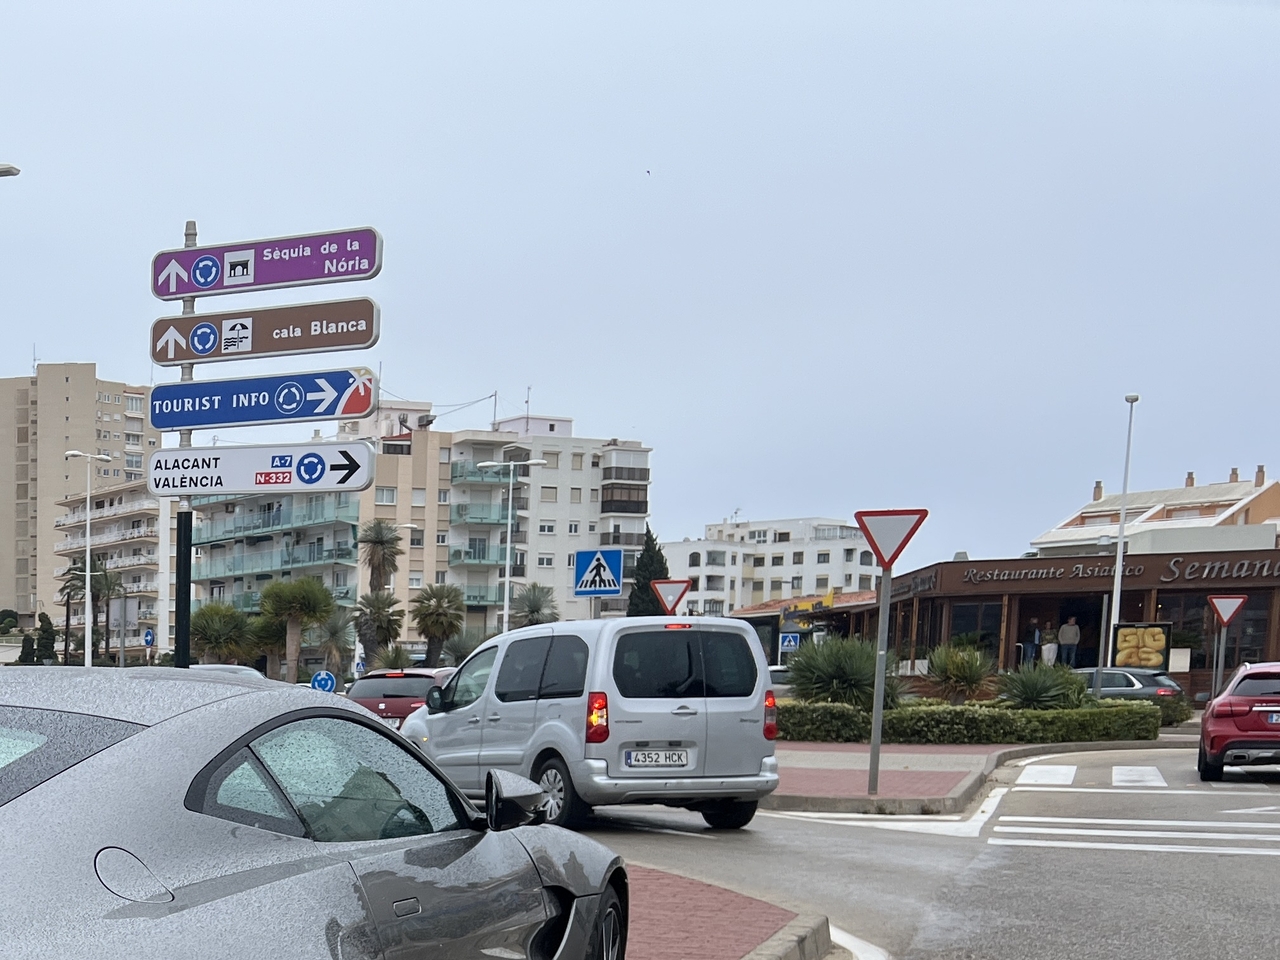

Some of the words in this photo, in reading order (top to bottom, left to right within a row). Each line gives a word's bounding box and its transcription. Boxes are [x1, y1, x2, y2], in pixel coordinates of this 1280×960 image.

[263, 244, 311, 261] Sèquia
[320, 241, 338, 255] de
[346, 238, 360, 251] la
[324, 257, 369, 274] Nória
[272, 326, 302, 339] cala
[310, 319, 367, 336] Blanca
[153, 396, 221, 414] TOURIST
[232, 391, 269, 408] INFO
[154, 457, 220, 471] ALACANT
[273, 456, 291, 467] A-7
[153, 474, 223, 488] VALÈNCIA
[256, 473, 290, 483] N-332
[963, 568, 1065, 584] Restaurante
[634, 752, 660, 763] 4352
[665, 752, 684, 763] HCK
